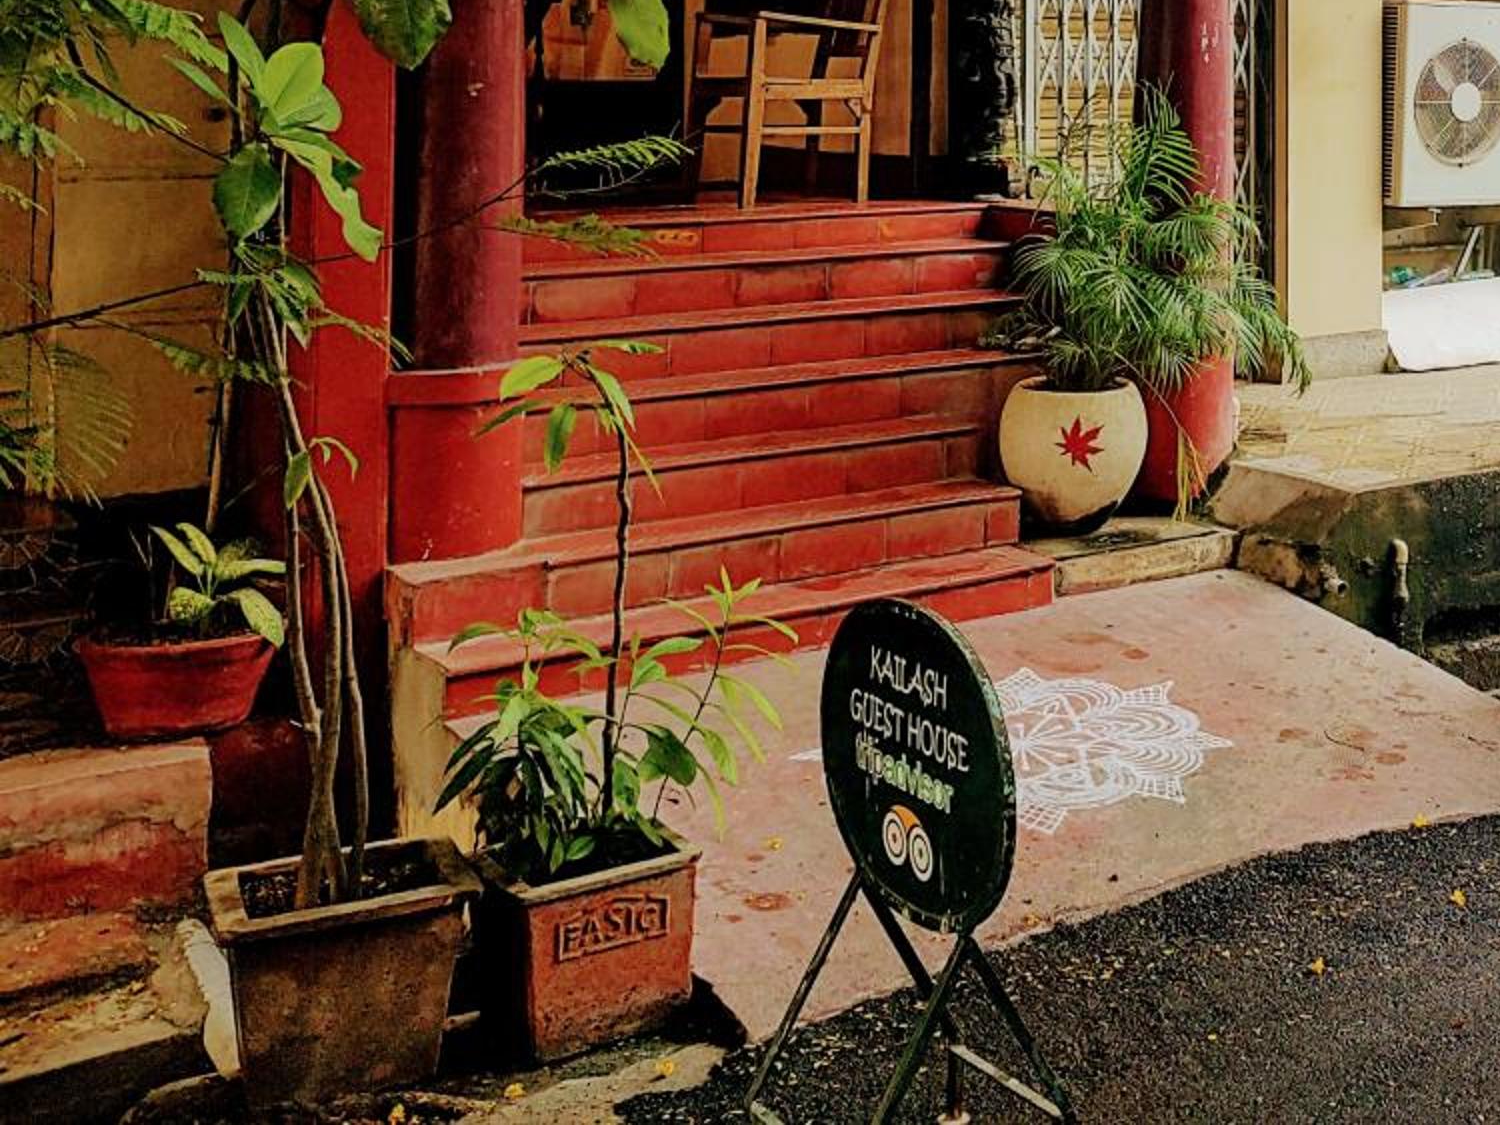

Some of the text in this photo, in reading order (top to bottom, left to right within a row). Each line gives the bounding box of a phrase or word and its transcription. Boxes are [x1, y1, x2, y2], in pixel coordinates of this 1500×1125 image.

[870, 646, 948, 710] KAILASH
[850, 689, 969, 772] GUEST HOUSE
